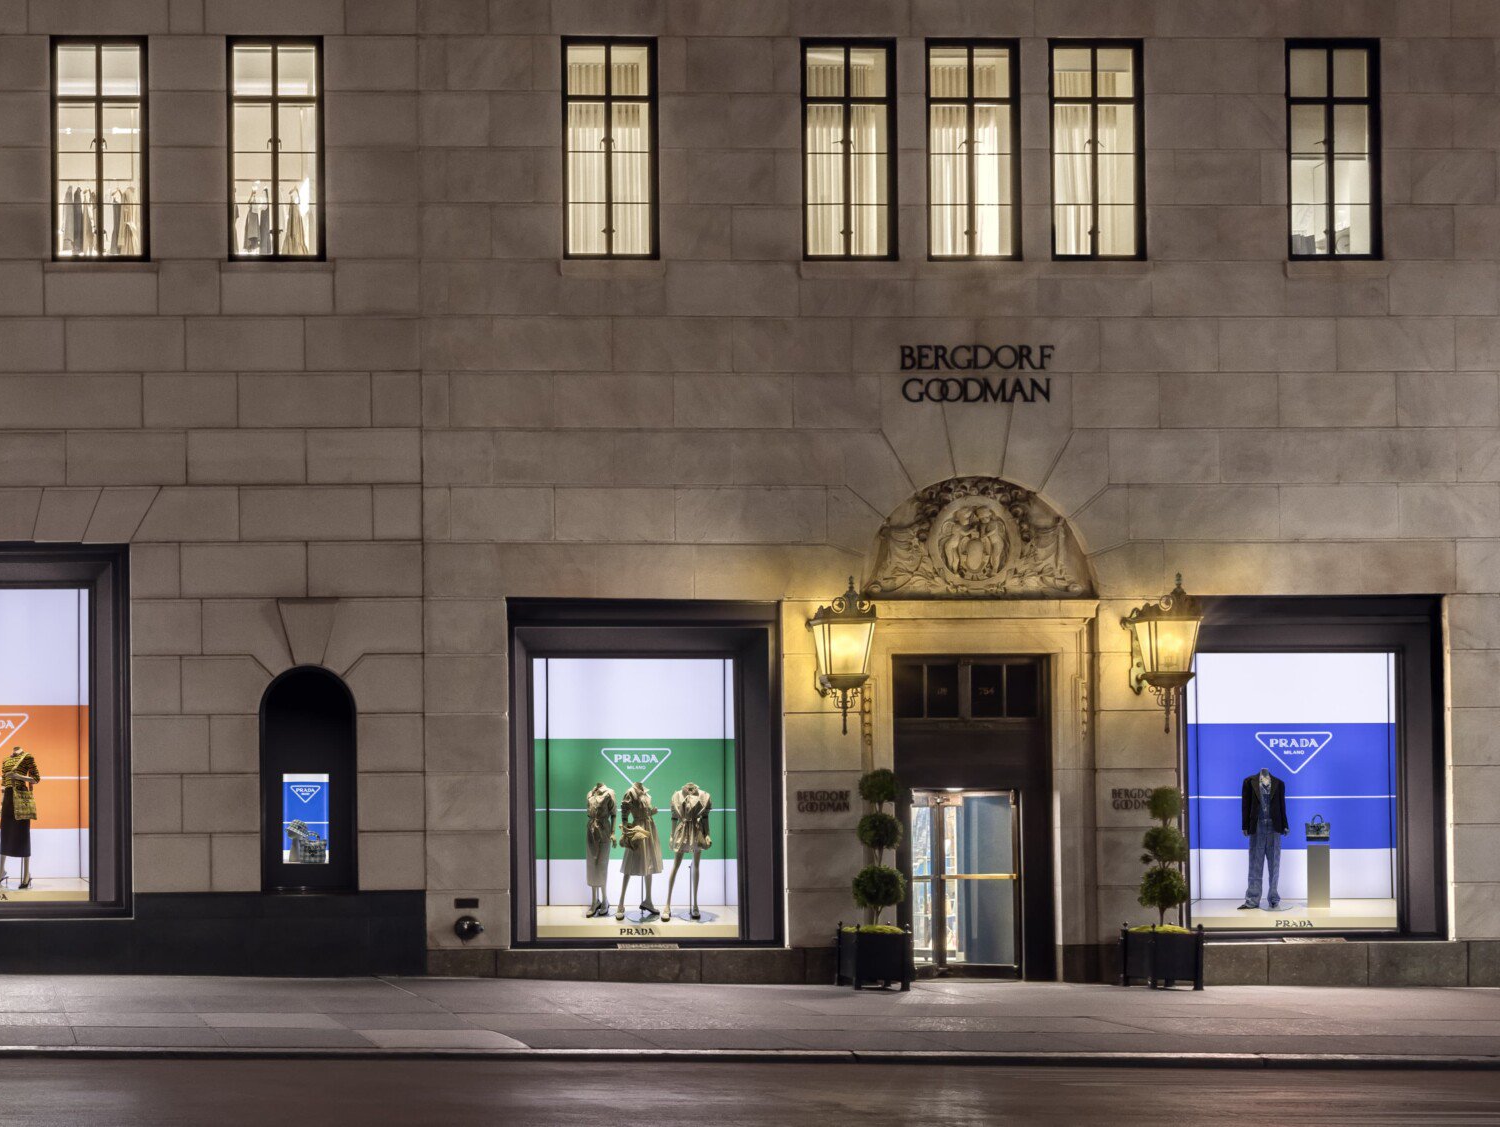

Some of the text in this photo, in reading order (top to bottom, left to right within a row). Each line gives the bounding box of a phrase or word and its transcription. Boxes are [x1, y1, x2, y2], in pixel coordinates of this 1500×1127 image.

[900, 345, 1055, 370] BERGDORF
[902, 378, 1050, 403] GOODMAN
[1269, 738, 1319, 748] PRADA
[613, 754, 659, 763] PRADA
[796, 790, 851, 801] BERGDORF
[1111, 788, 1153, 799] BERGDO
[797, 801, 850, 812] GOODMAN
[1112, 799, 1150, 810] GOODM
[1275, 919, 1313, 928] PRADA
[619, 927, 655, 936] PRADA
